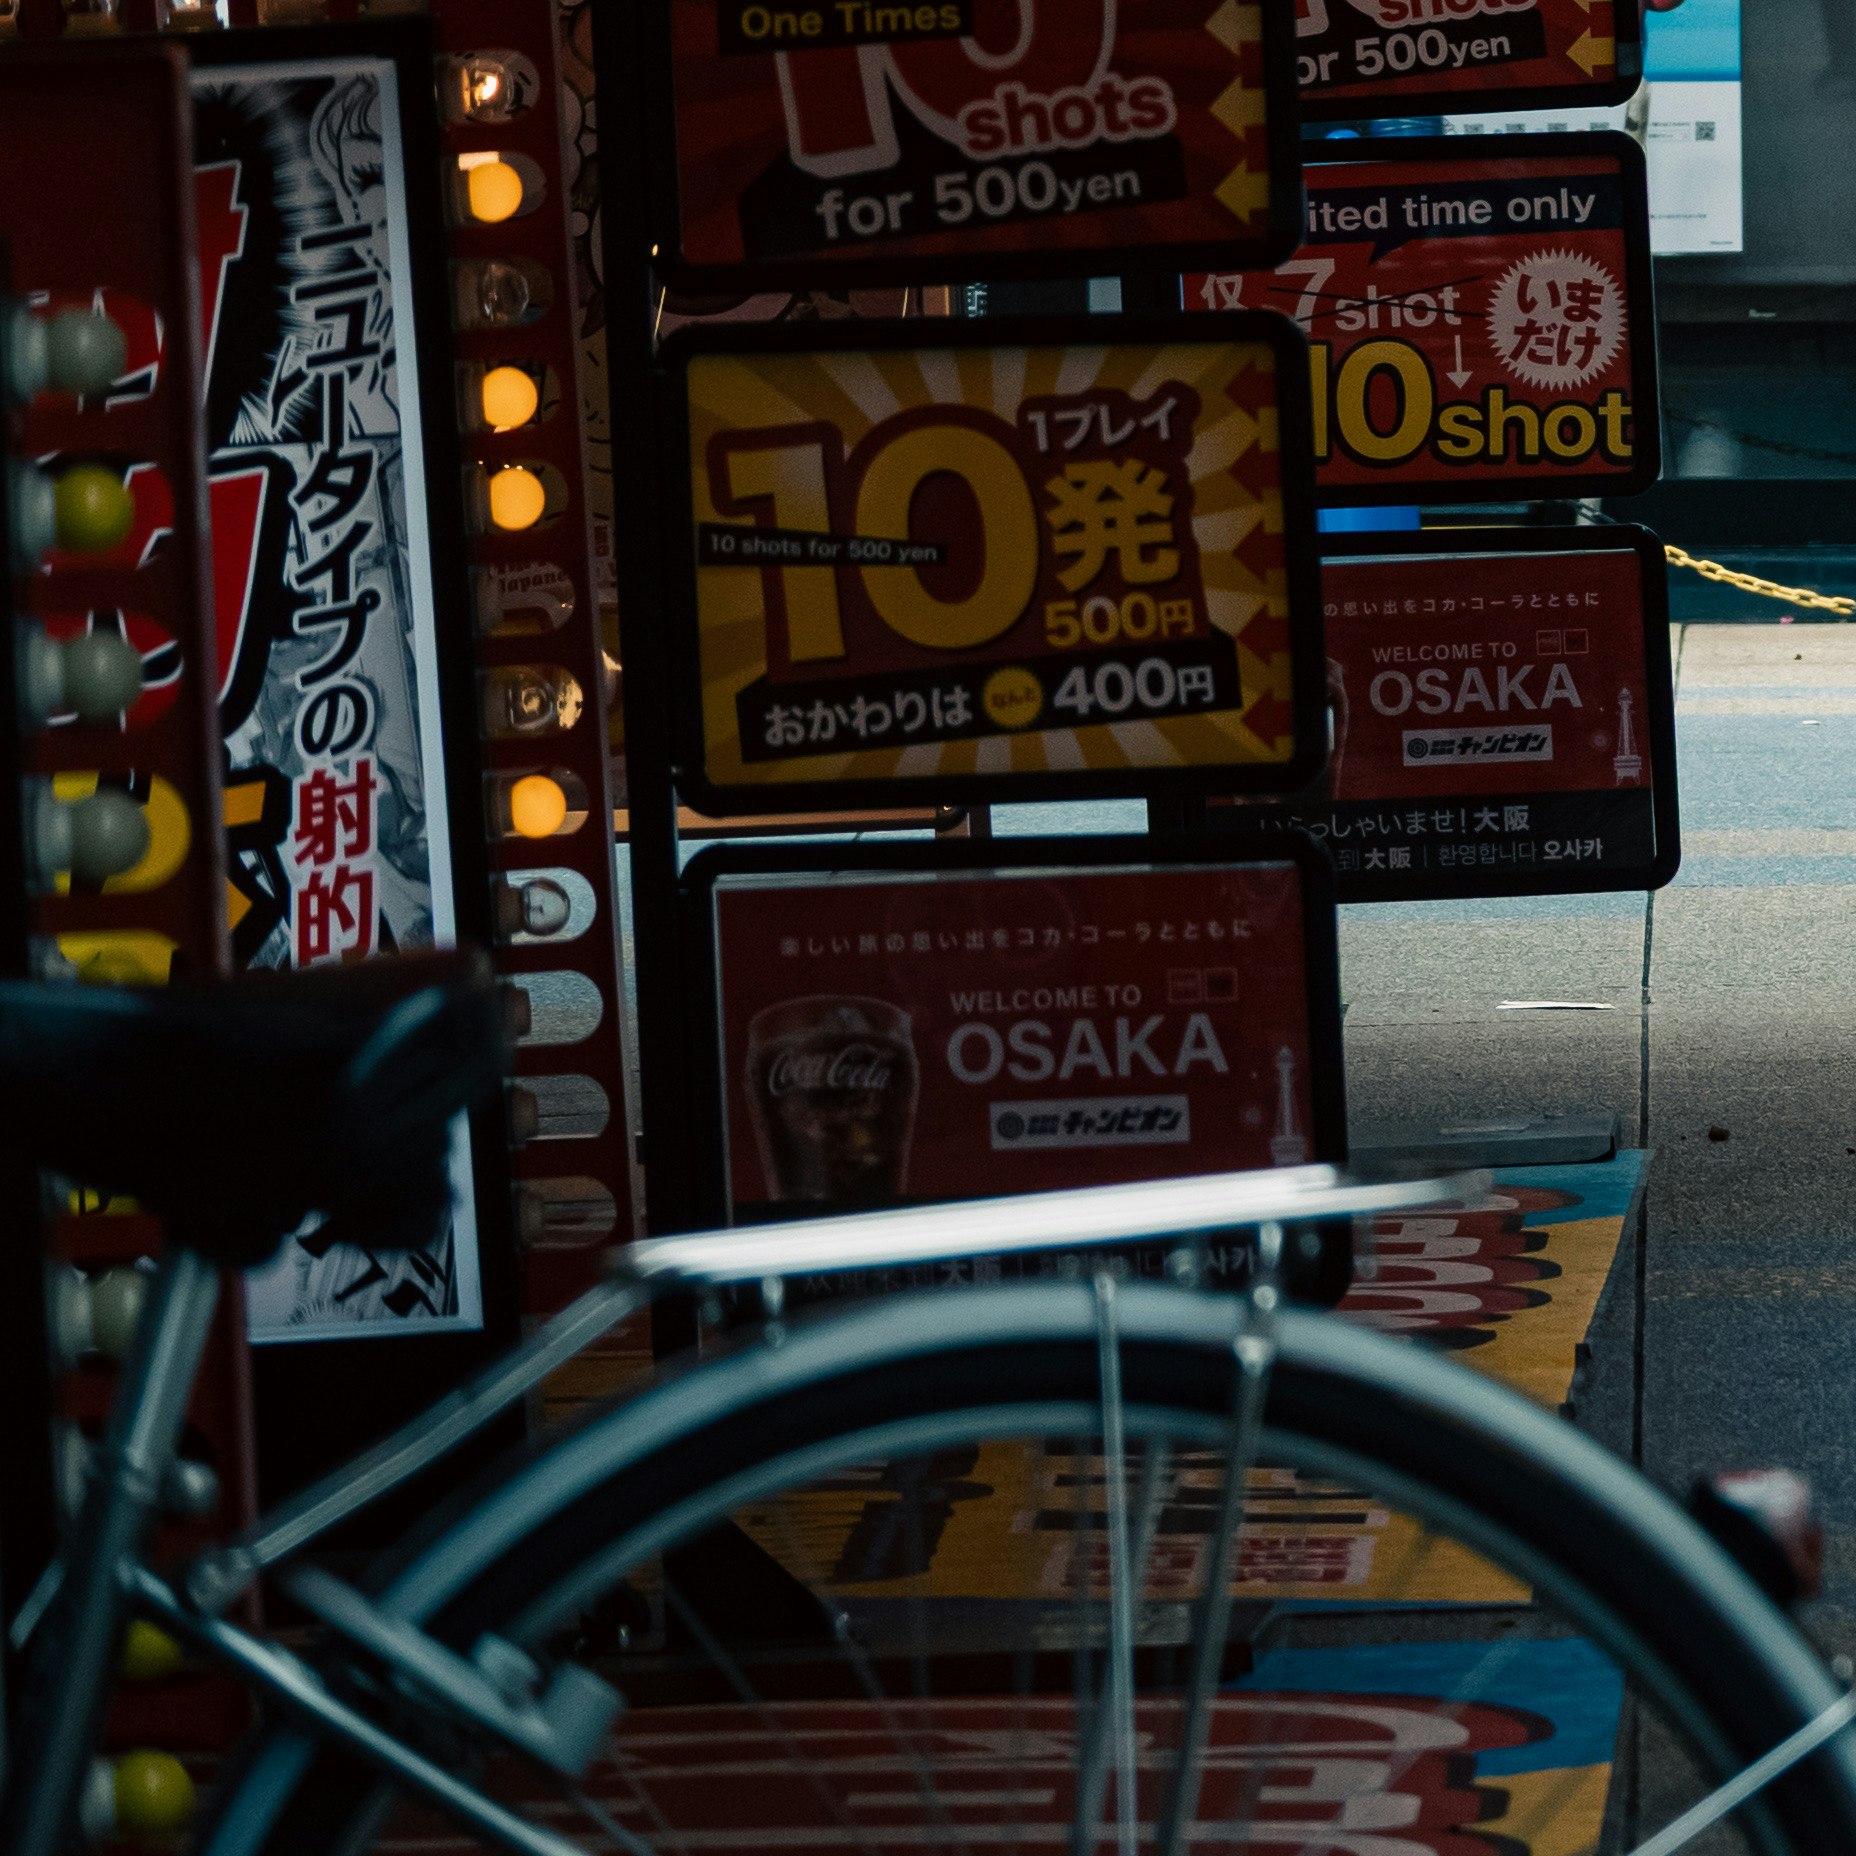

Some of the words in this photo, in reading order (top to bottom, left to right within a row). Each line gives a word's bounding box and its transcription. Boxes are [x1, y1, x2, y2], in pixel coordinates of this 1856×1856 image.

[740, 6, 824, 39] One
[834, 1, 961, 34] Times
[1296, 50, 1340, 86] or
[961, 79, 1174, 156] shots
[815, 189, 913, 239] for
[1308, 196, 1388, 233] ited
[1402, 194, 1493, 228] time
[1507, 187, 1597, 224] only
[1516, 273, 1604, 323] いま
[1511, 320, 1602, 371] だけ
[710, 534, 735, 554] 10
[741, 536, 801, 557] shots
[808, 539, 841, 559] for
[848, 541, 891, 562] 500
[898, 545, 938, 566] yen
[1044, 592, 1196, 649] 500円
[1370, 644, 1484, 664] WELCOME
[1488, 642, 1518, 659] TO
[763, 684, 974, 747] おかわりは
[1052, 655, 1217, 717] 400円
[1368, 662, 1584, 717] OSAKA
[1438, 842, 1537, 867] 환영합니다
[1543, 837, 1604, 862] 오사카
[950, 985, 1099, 1014] WELCOME
[1104, 984, 1143, 1008] TO
[945, 1012, 1230, 1085] OSAKA
